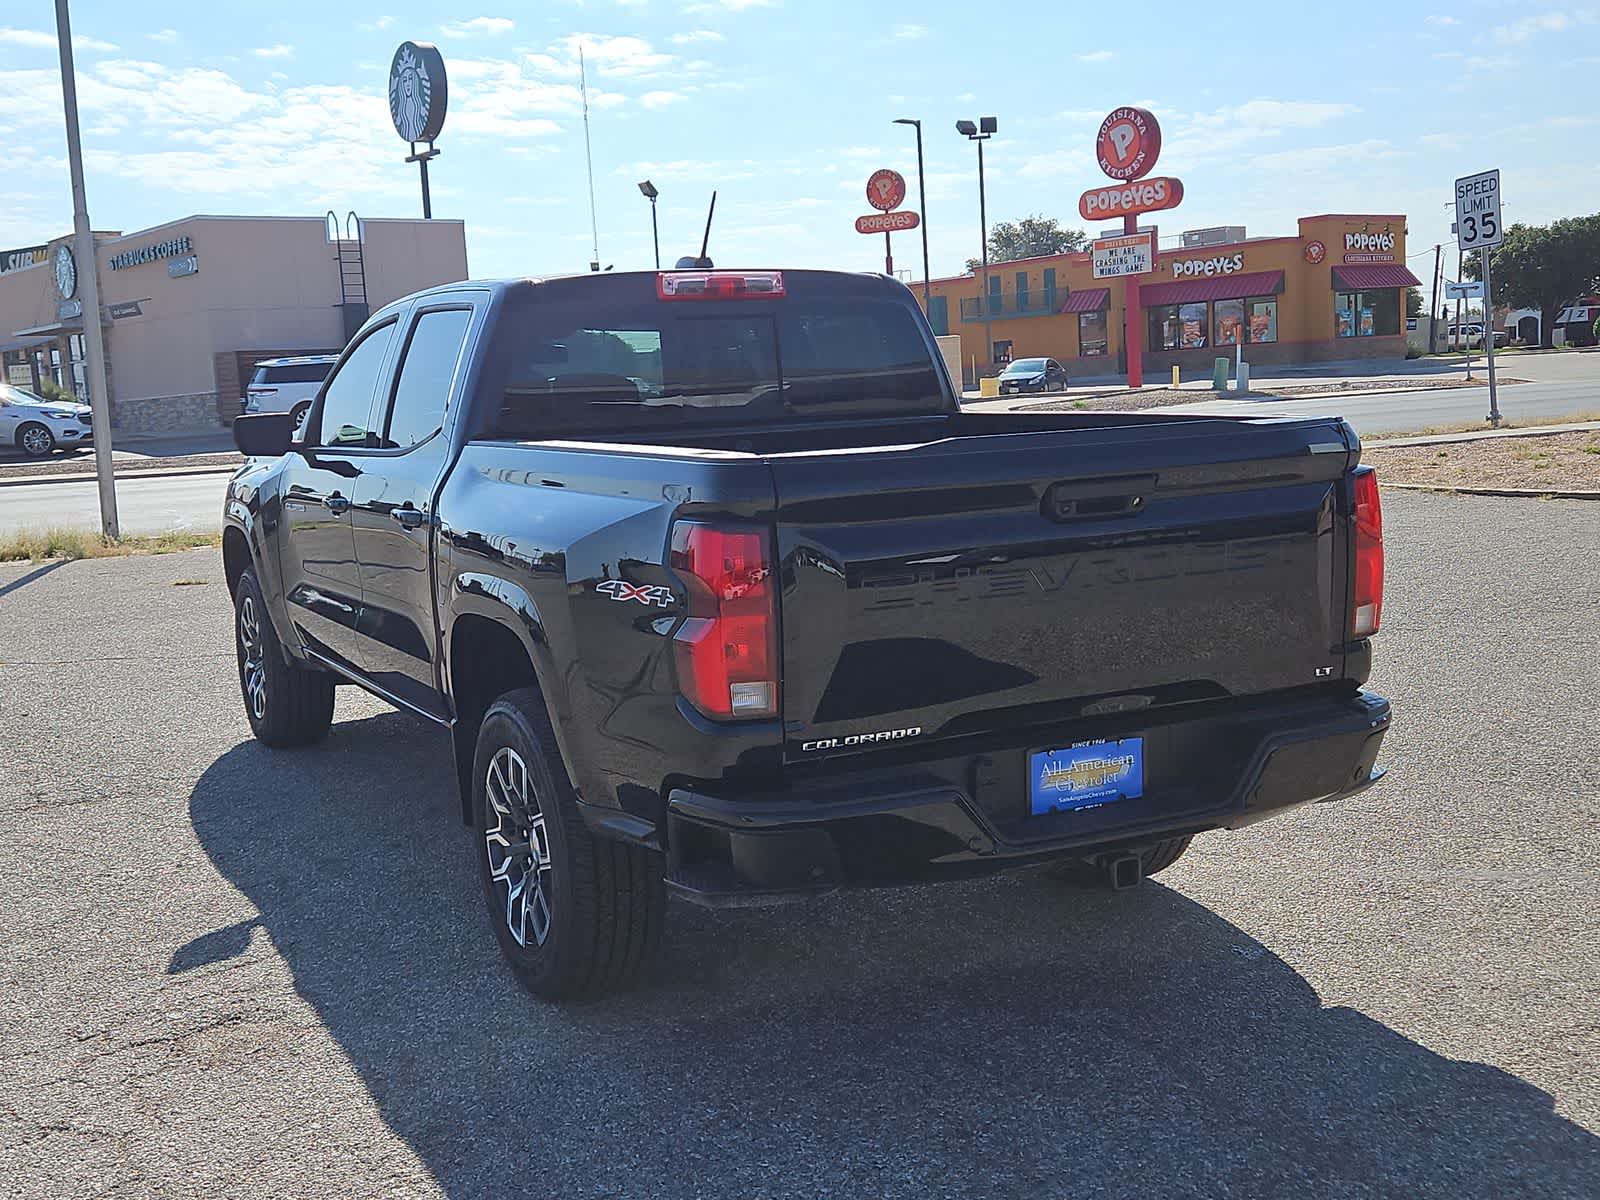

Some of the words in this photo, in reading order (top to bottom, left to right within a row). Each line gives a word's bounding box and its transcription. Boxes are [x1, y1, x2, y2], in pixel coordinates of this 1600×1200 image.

[1099, 109, 1147, 142] LOUISIANA
[1109, 124, 1135, 161] P
[1099, 150, 1145, 178] KITCHEN
[875, 179, 892, 199] P
[1085, 180, 1166, 214] POPeYeS
[1457, 177, 1498, 199] SPEED
[1462, 195, 1493, 215] LIMIT
[1463, 211, 1497, 243] 35
[156, 237, 192, 259] COFFEE
[1109, 249, 1119, 257] WE
[1123, 246, 1136, 256] ARE
[1344, 232, 1396, 252] POPeYeS
[1095, 256, 1128, 267] CRASHING
[1133, 254, 1145, 263] THE
[1099, 265, 1120, 276] WINGS
[1125, 263, 1144, 273] GAME
[1172, 254, 1243, 279] POPeYeS
[596, 580, 675, 608] 4X4
[1315, 666, 1334, 677] LT
[802, 726, 921, 751] COLORADO
[1071, 740, 1091, 750] SINCE
[1040, 760, 1062, 778] All
[1068, 753, 1135, 774] American
[1055, 768, 1119, 792] Chevrolet
